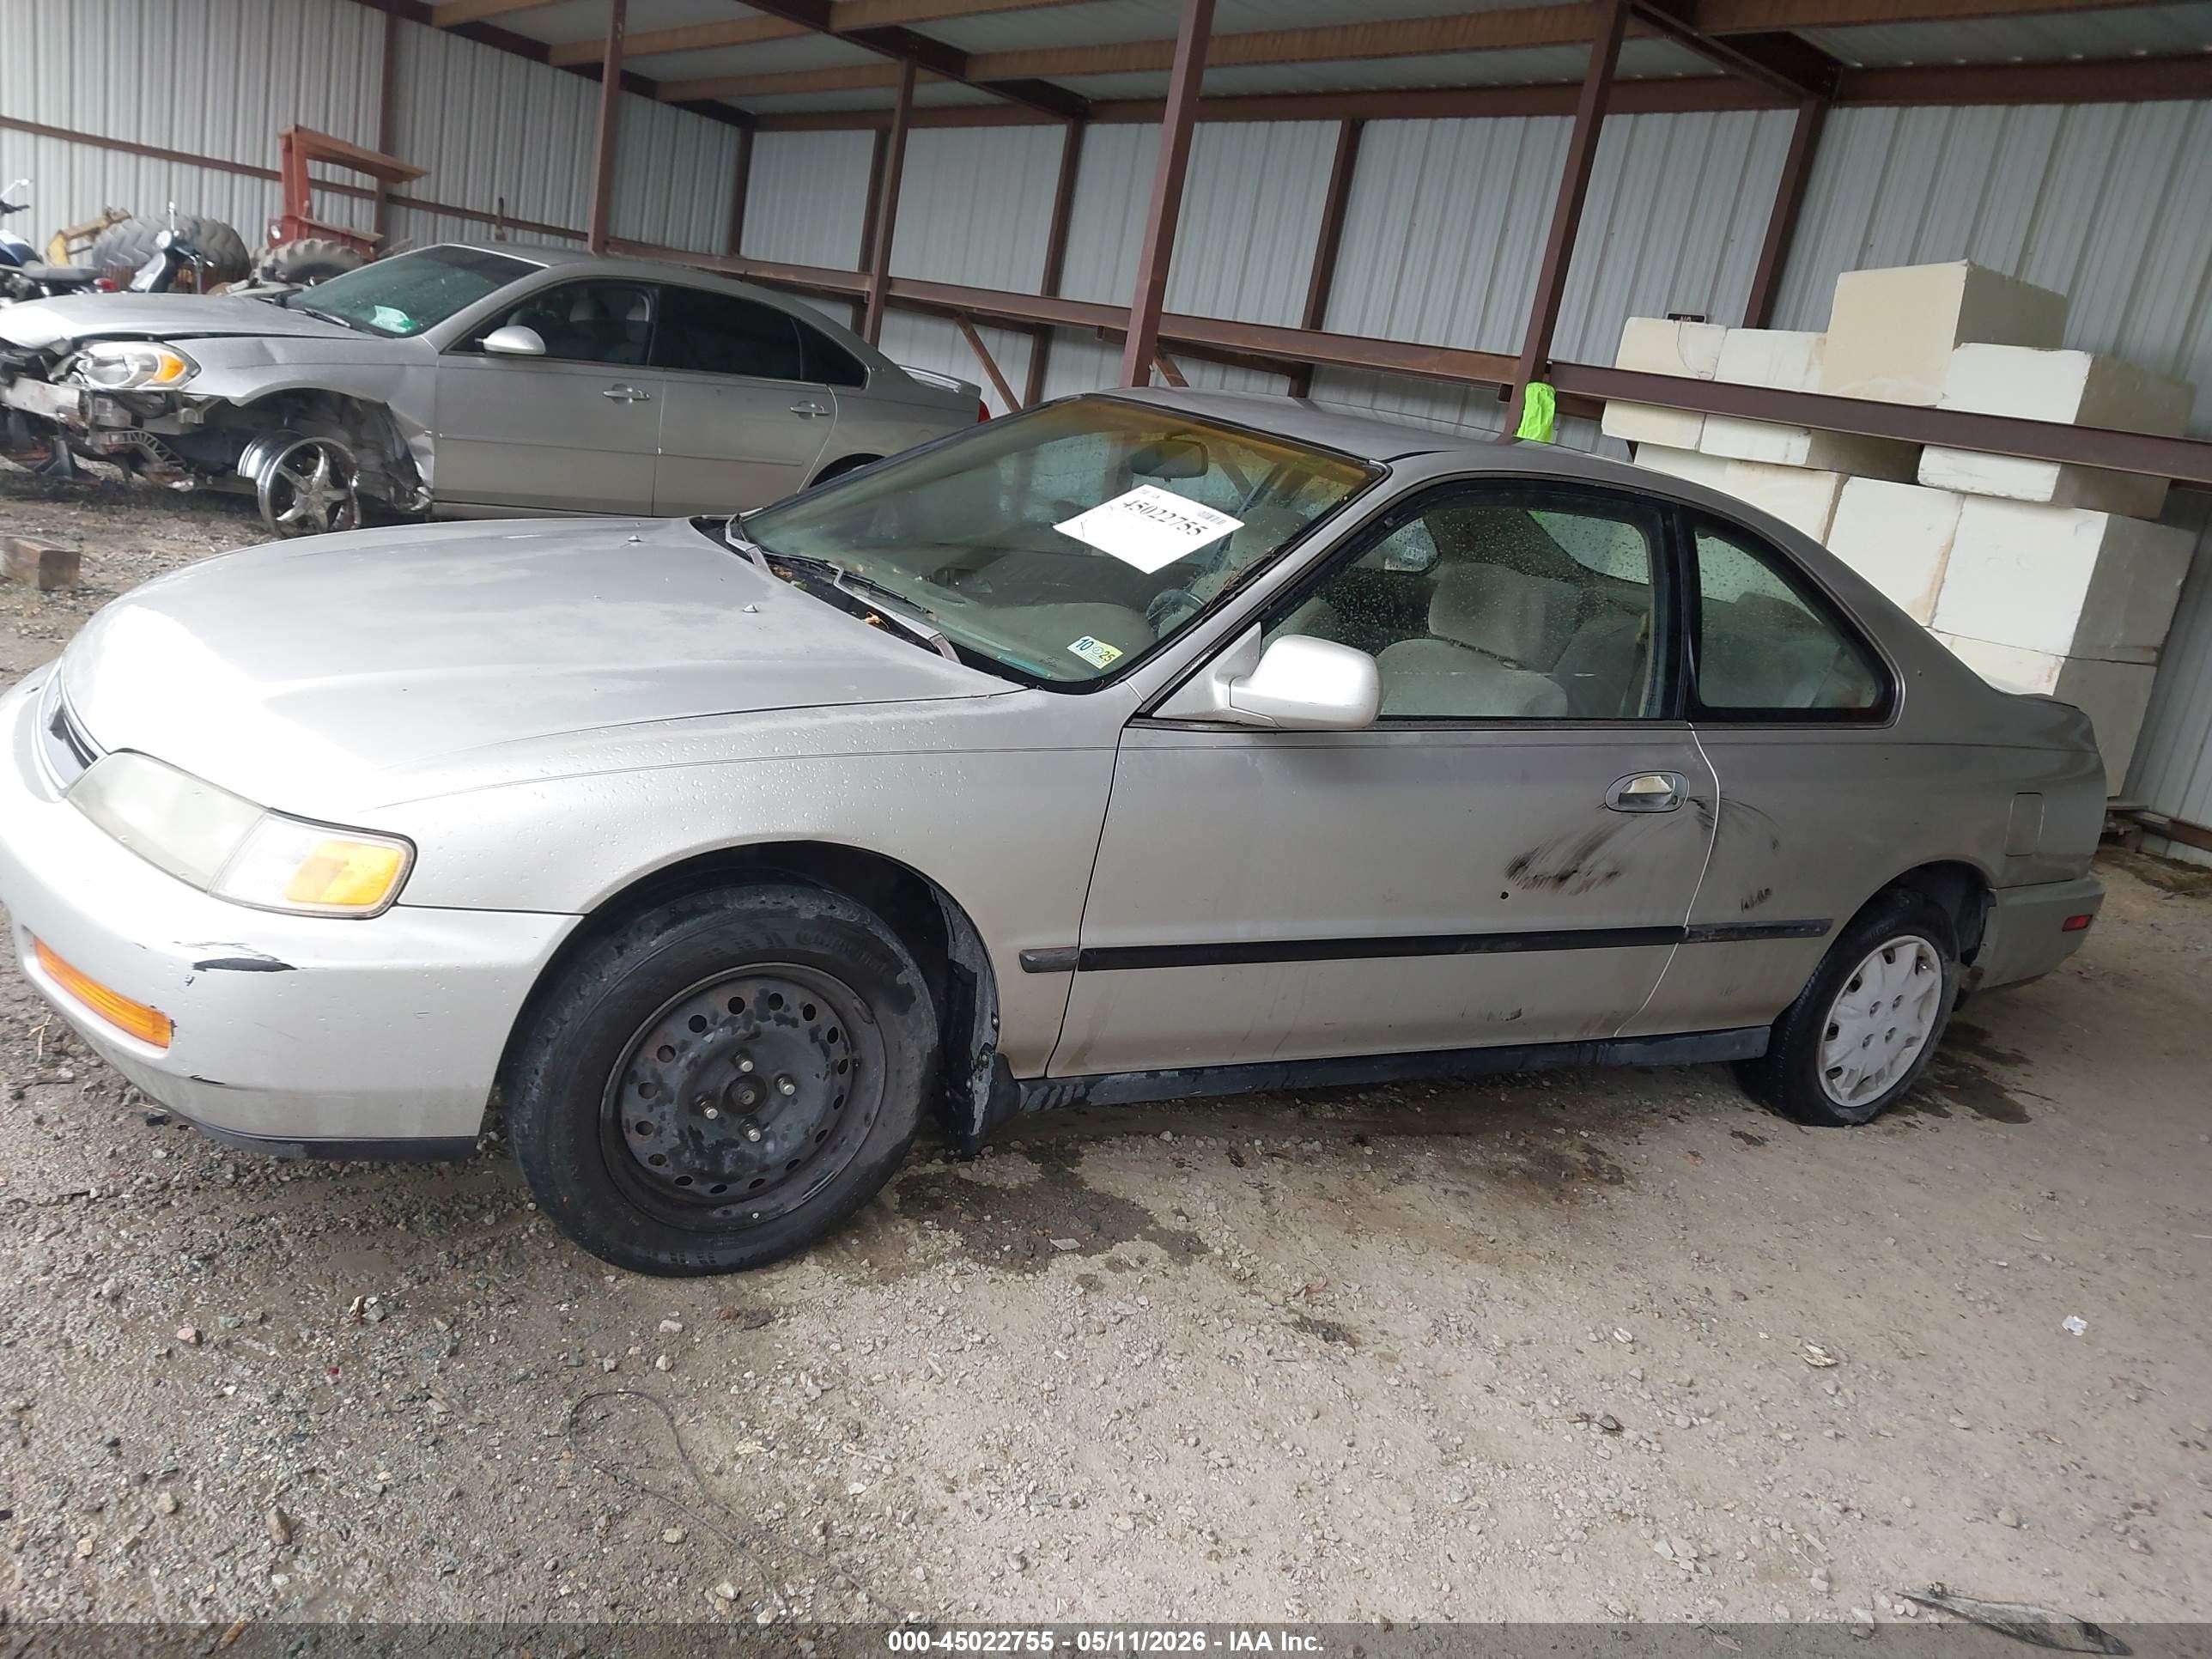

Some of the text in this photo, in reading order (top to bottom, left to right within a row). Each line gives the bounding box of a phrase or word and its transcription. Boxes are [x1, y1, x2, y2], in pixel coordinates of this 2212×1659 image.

[1122, 500, 1208, 536] 45022755
[1076, 638, 1095, 651] 10
[1099, 651, 1115, 662] 25
